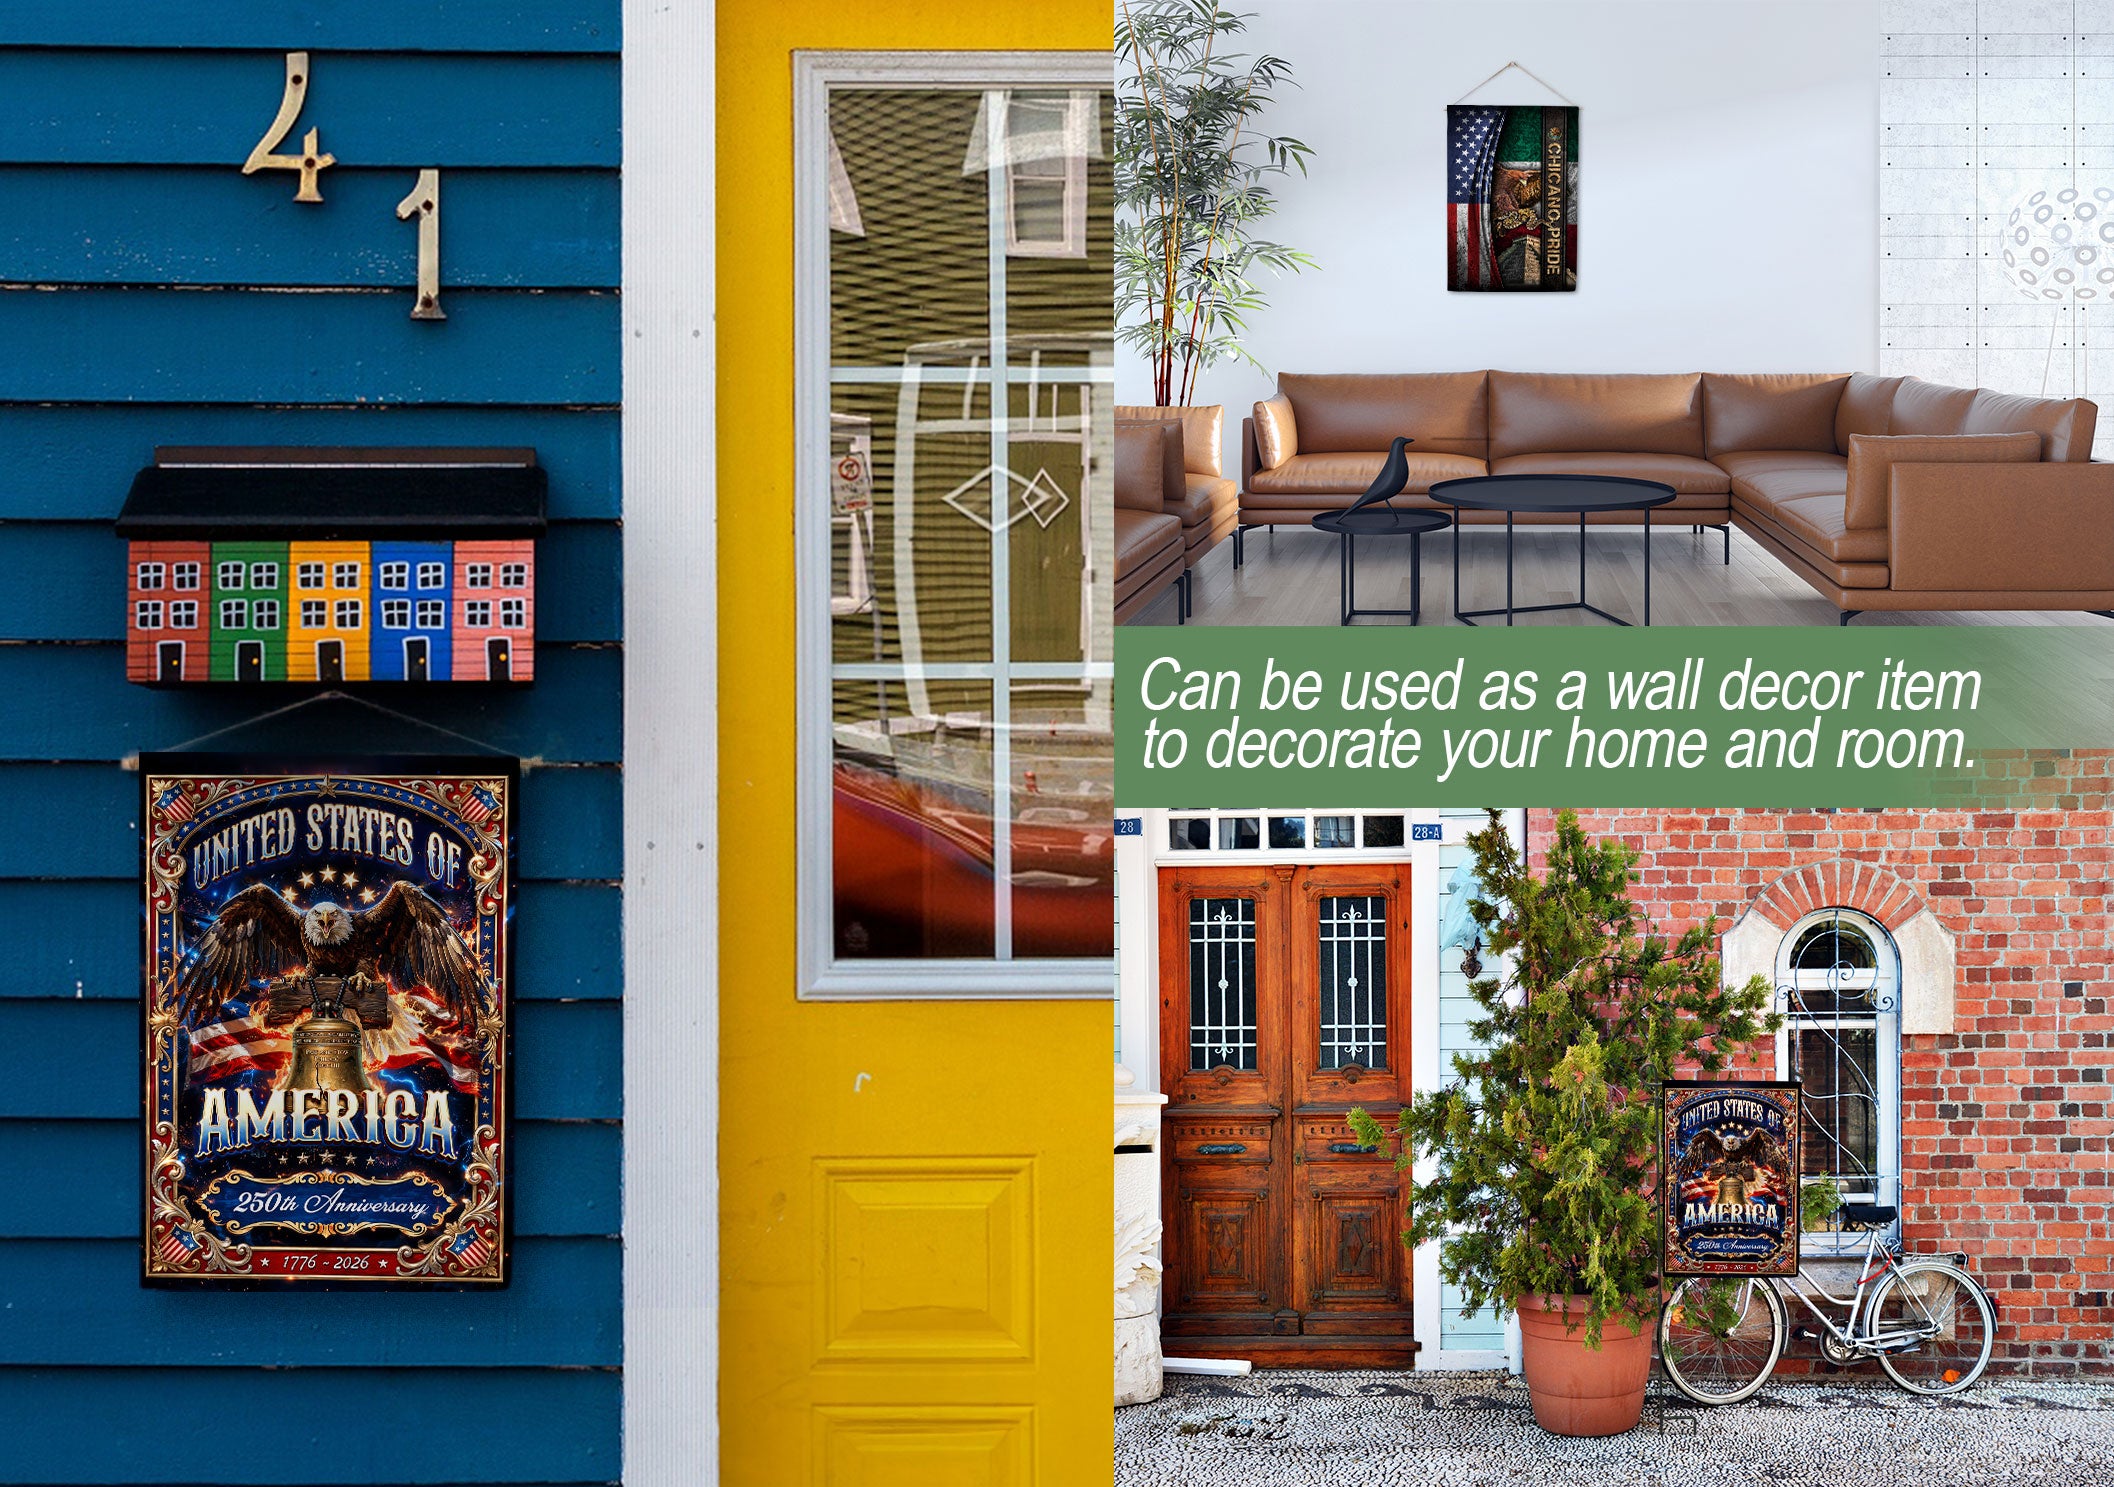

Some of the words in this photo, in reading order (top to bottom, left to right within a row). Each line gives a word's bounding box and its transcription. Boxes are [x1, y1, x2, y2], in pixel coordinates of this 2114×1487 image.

[1547, 142, 1562, 222] CHICANO
[1547, 227, 1561, 275] PRIDE
[1120, 821, 1134, 834] 28
[1414, 826, 1440, 839] 28-A
[193, 809, 296, 890] UNITED
[306, 803, 415, 868] STATES
[426, 836, 462, 890] OF
[194, 1087, 457, 1161] AMERICA
[1682, 1101, 1721, 1130] UNITED
[1723, 1099, 1764, 1123] STATES
[1767, 1108, 1781, 1130] OF
[233, 1191, 299, 1213] 250th
[303, 1187, 430, 1220] Anniversary
[1683, 1203, 1780, 1230] AMERICA
[283, 1254, 319, 1271] 1776
[333, 1254, 370, 1270] 2026
